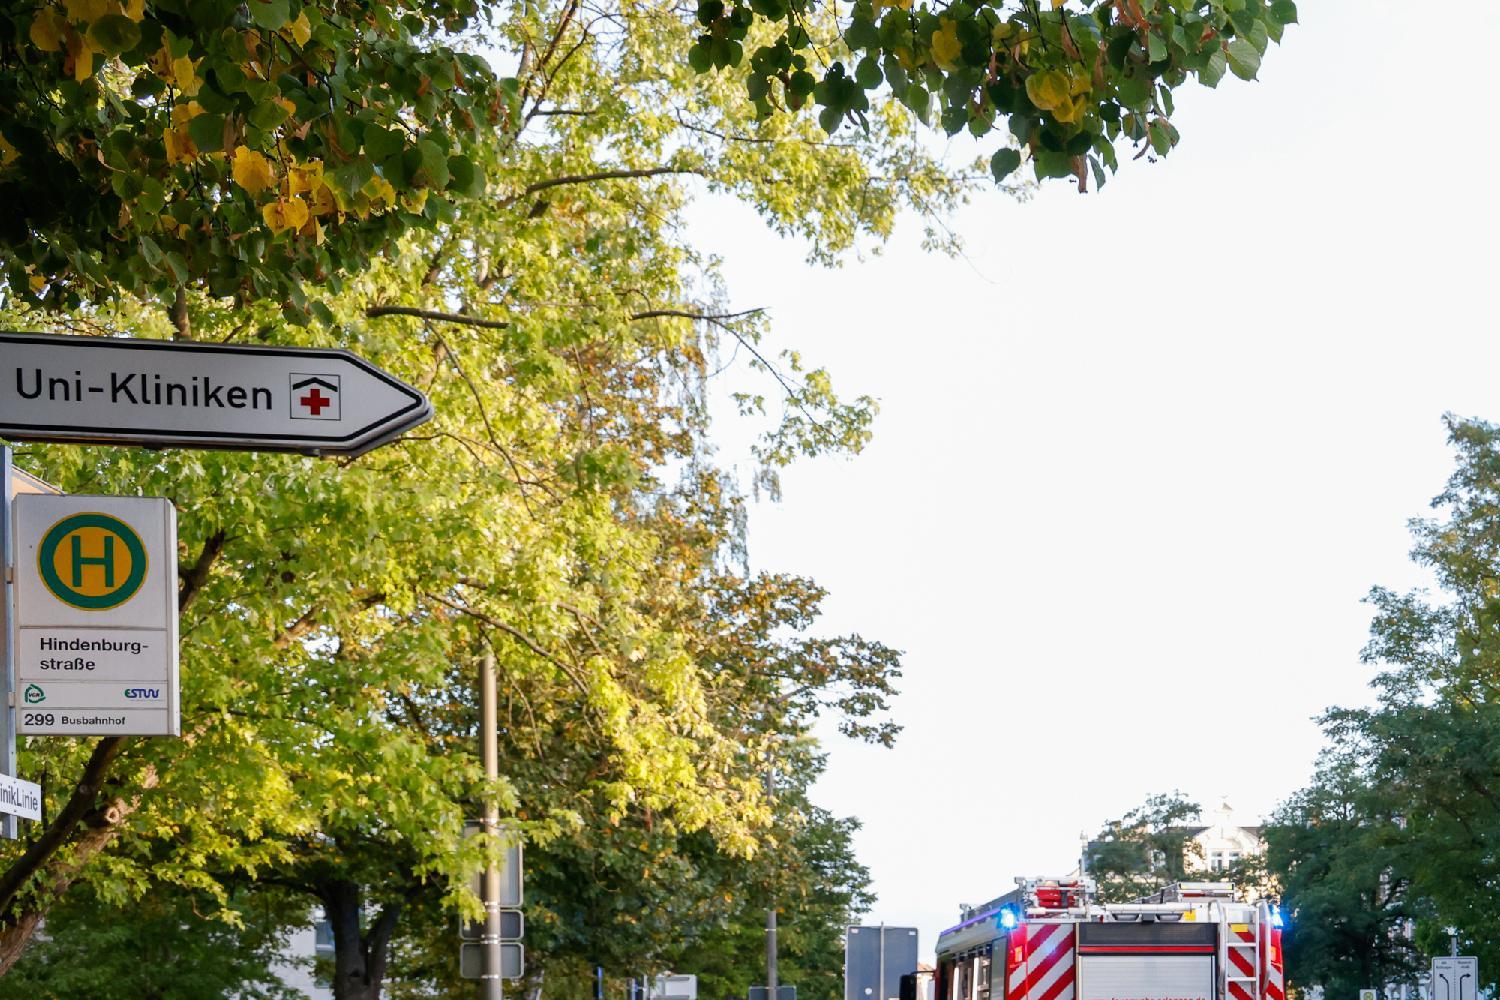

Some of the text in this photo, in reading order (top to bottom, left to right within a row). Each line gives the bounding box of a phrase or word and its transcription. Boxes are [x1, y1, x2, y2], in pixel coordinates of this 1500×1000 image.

[16, 367, 273, 411] Uni-Kliniken
[71, 535, 114, 588] H
[40, 637, 149, 654] Hindenburg-
[40, 658, 96, 671] straße
[24, 713, 126, 726] 299 Busbahnhof
